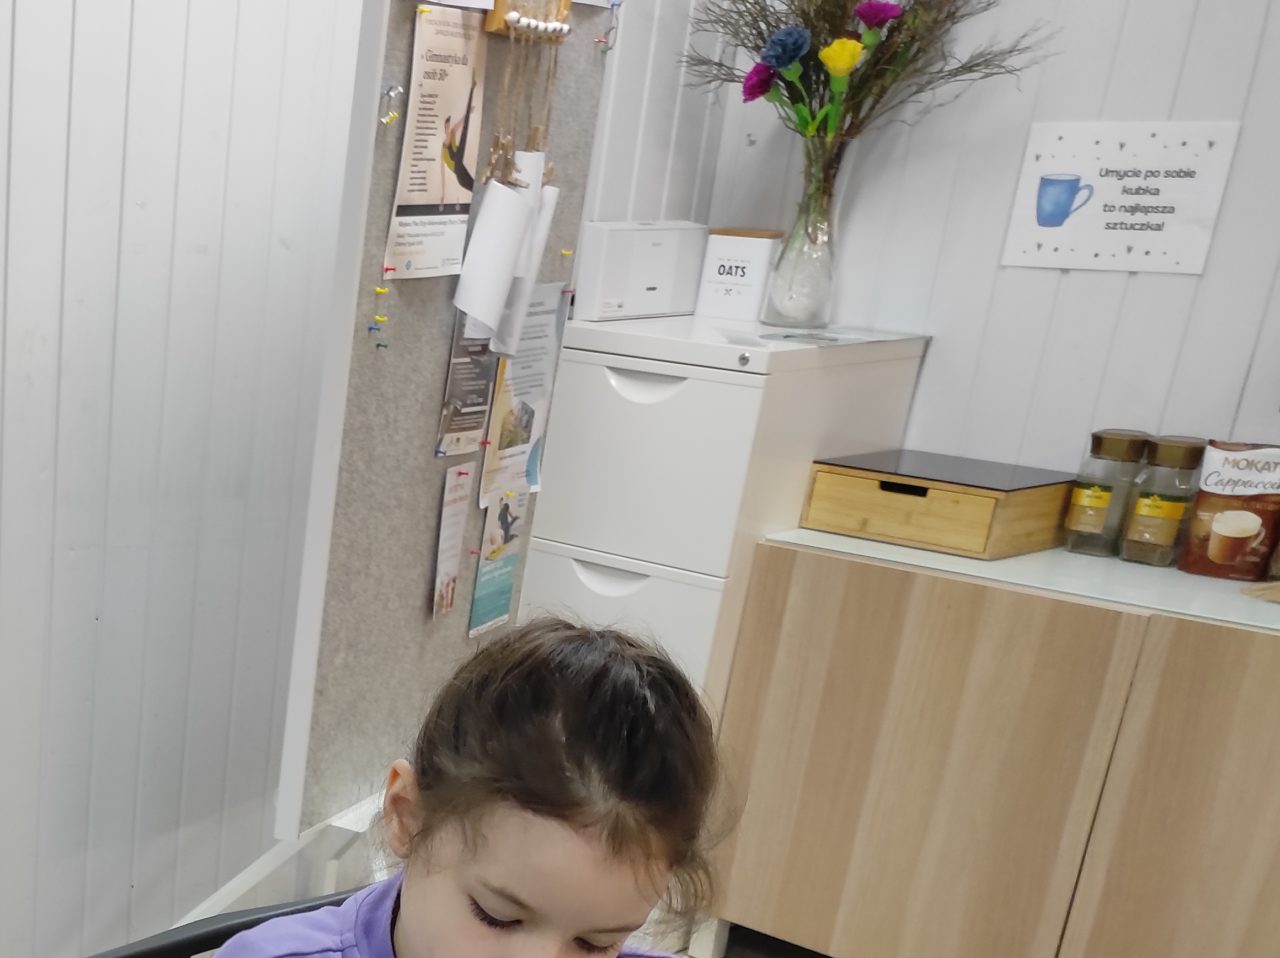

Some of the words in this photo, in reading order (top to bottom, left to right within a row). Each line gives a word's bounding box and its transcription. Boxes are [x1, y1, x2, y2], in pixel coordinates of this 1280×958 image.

[1099, 167, 1142, 181] Umycie
[1143, 169, 1161, 181] po
[1163, 167, 1197, 179] sobie
[1121, 185, 1161, 196] kubka
[1102, 203, 1117, 213] to
[1118, 203, 1176, 216] najlepsza
[1104, 221, 1165, 232] sztuczka!
[717, 264, 747, 278] OATS
